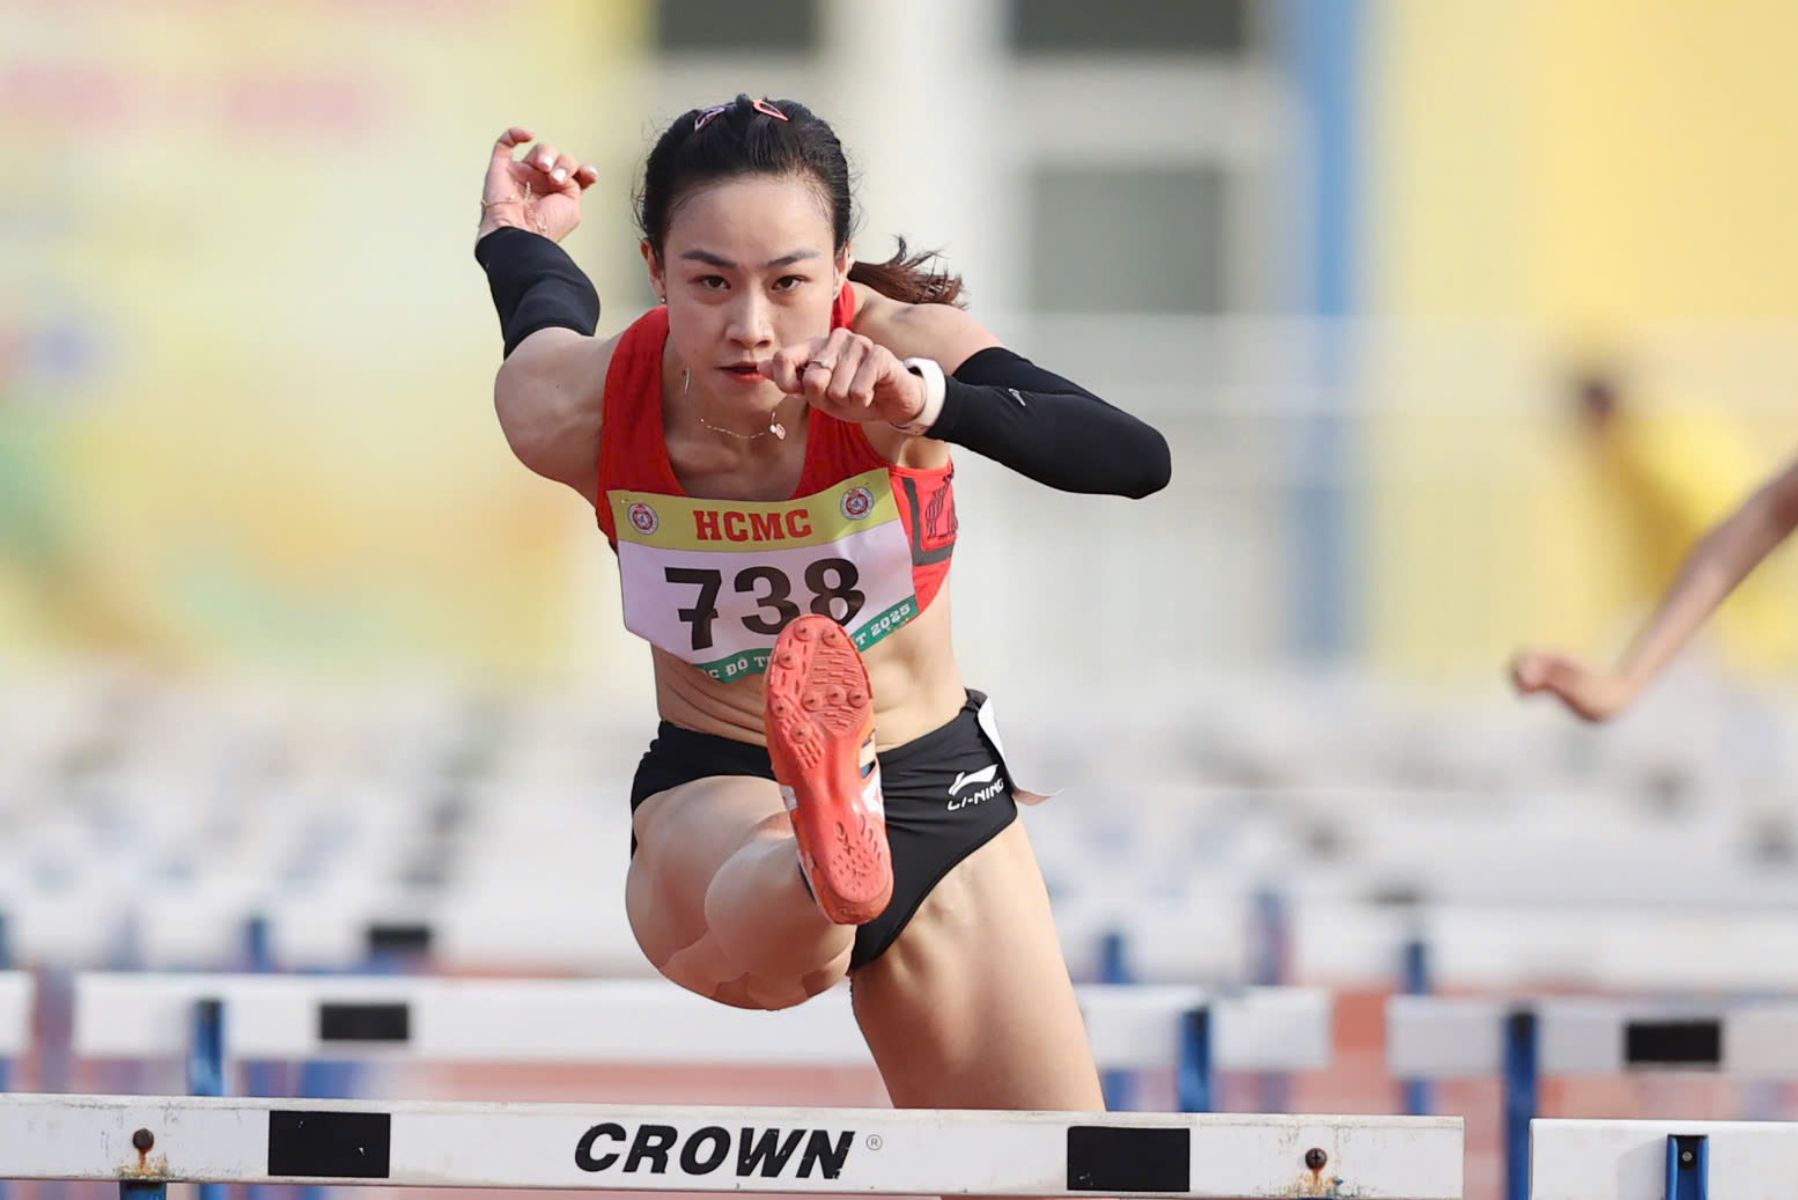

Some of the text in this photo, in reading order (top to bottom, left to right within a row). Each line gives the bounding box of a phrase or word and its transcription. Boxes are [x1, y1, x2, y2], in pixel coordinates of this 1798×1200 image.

[693, 509, 812, 542] HCMC
[664, 558, 866, 650] 738
[870, 603, 911, 637] 2025
[947, 778, 1004, 811] LI-NING
[574, 1122, 856, 1180] CROWN
